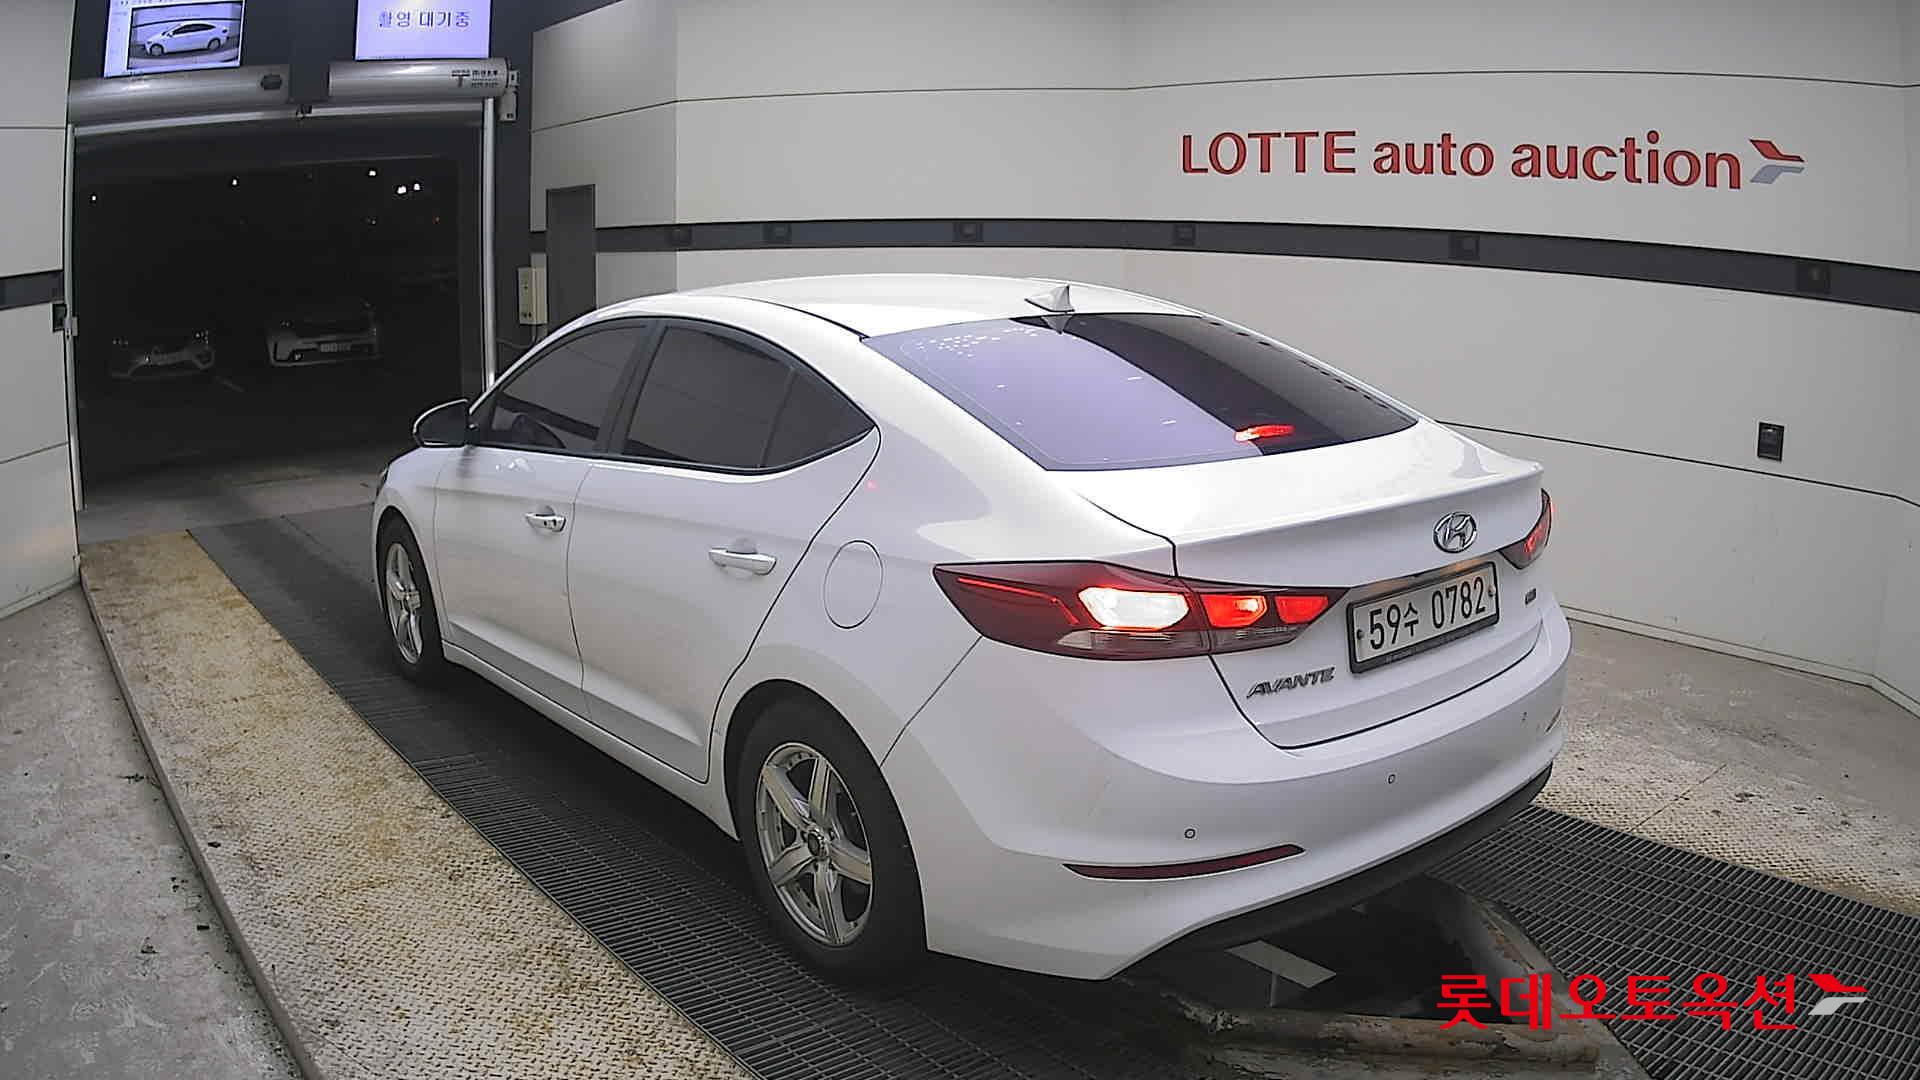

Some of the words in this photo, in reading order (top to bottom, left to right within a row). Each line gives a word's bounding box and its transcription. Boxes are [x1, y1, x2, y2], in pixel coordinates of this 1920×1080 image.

[419, 11, 470, 28] 대기중
[1181, 130, 1357, 175] LOTTE
[1373, 132, 1495, 177] auto
[1511, 130, 1742, 190] auction
[1369, 602, 1419, 650] 59수
[1431, 576, 1486, 629] 0782
[1246, 666, 1335, 699] AVANTE
